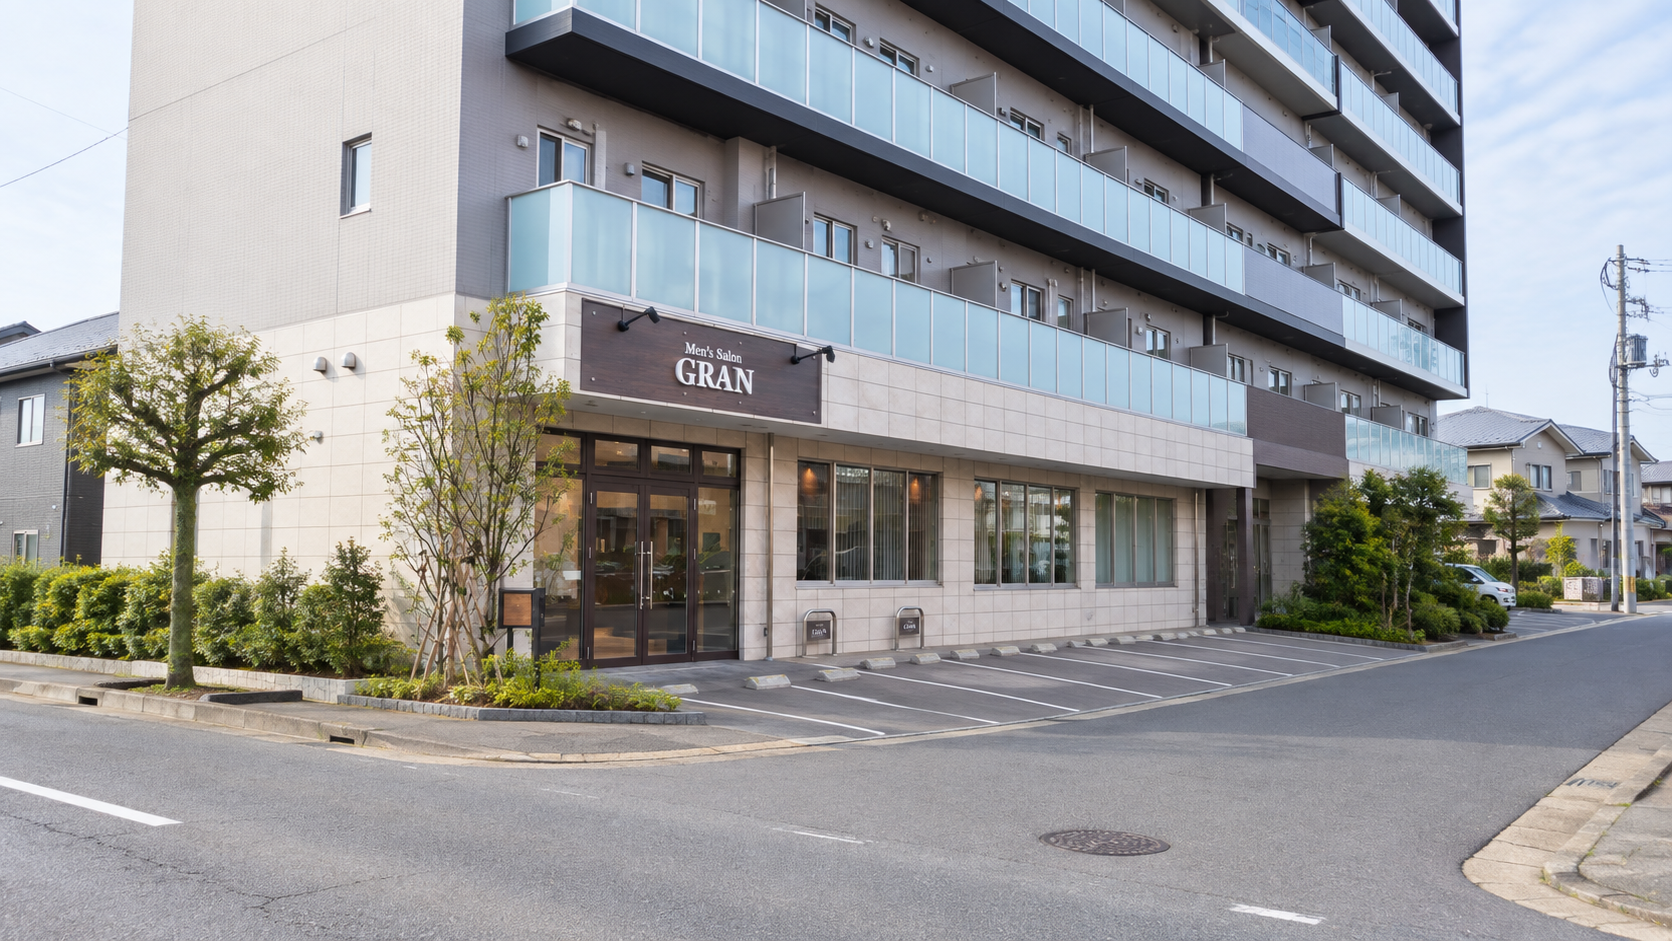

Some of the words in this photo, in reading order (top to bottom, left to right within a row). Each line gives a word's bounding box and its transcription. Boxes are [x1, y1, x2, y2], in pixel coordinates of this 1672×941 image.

[684, 341, 714, 359] Men's
[716, 347, 743, 364] Salon
[675, 357, 755, 395] GRAN
